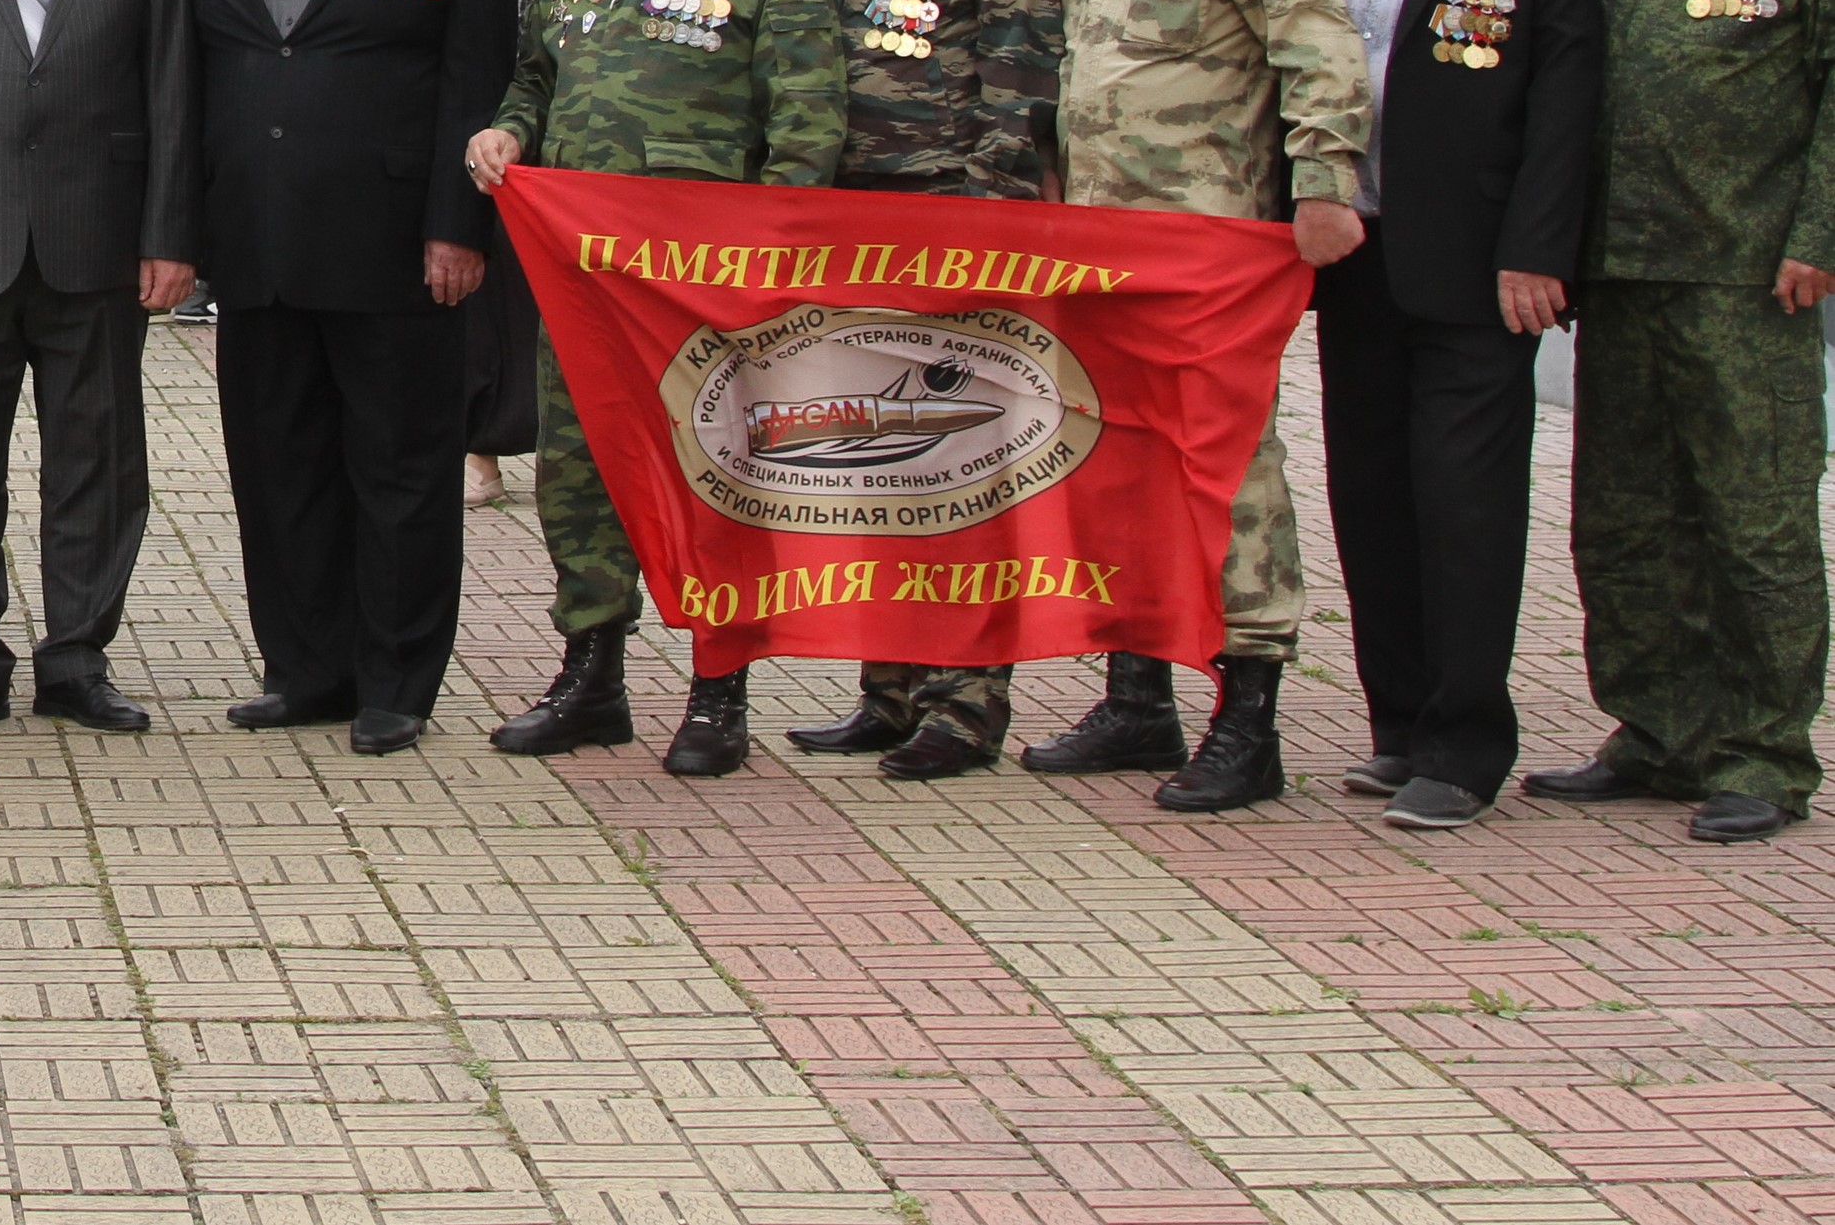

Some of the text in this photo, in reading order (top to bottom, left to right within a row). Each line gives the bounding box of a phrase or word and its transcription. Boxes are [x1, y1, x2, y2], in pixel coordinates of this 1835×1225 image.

[577, 232, 837, 289] ПАМЯТИ
[833, 330, 933, 346] ЕТЕРАНОВ
[942, 338, 1053, 401] АФГАНИСТАН
[696, 439, 1075, 526] РЕГИОНАЛЬНАЯ ОРГАНИЗАЦИЯ
[717, 417, 1047, 488] И СПЕЦИАЛЬНЫХ ВОЕННЫХ ОПЕРАЦИЙ
[680, 556, 1121, 627] ВО ИМЯ ЖИВЫХ
